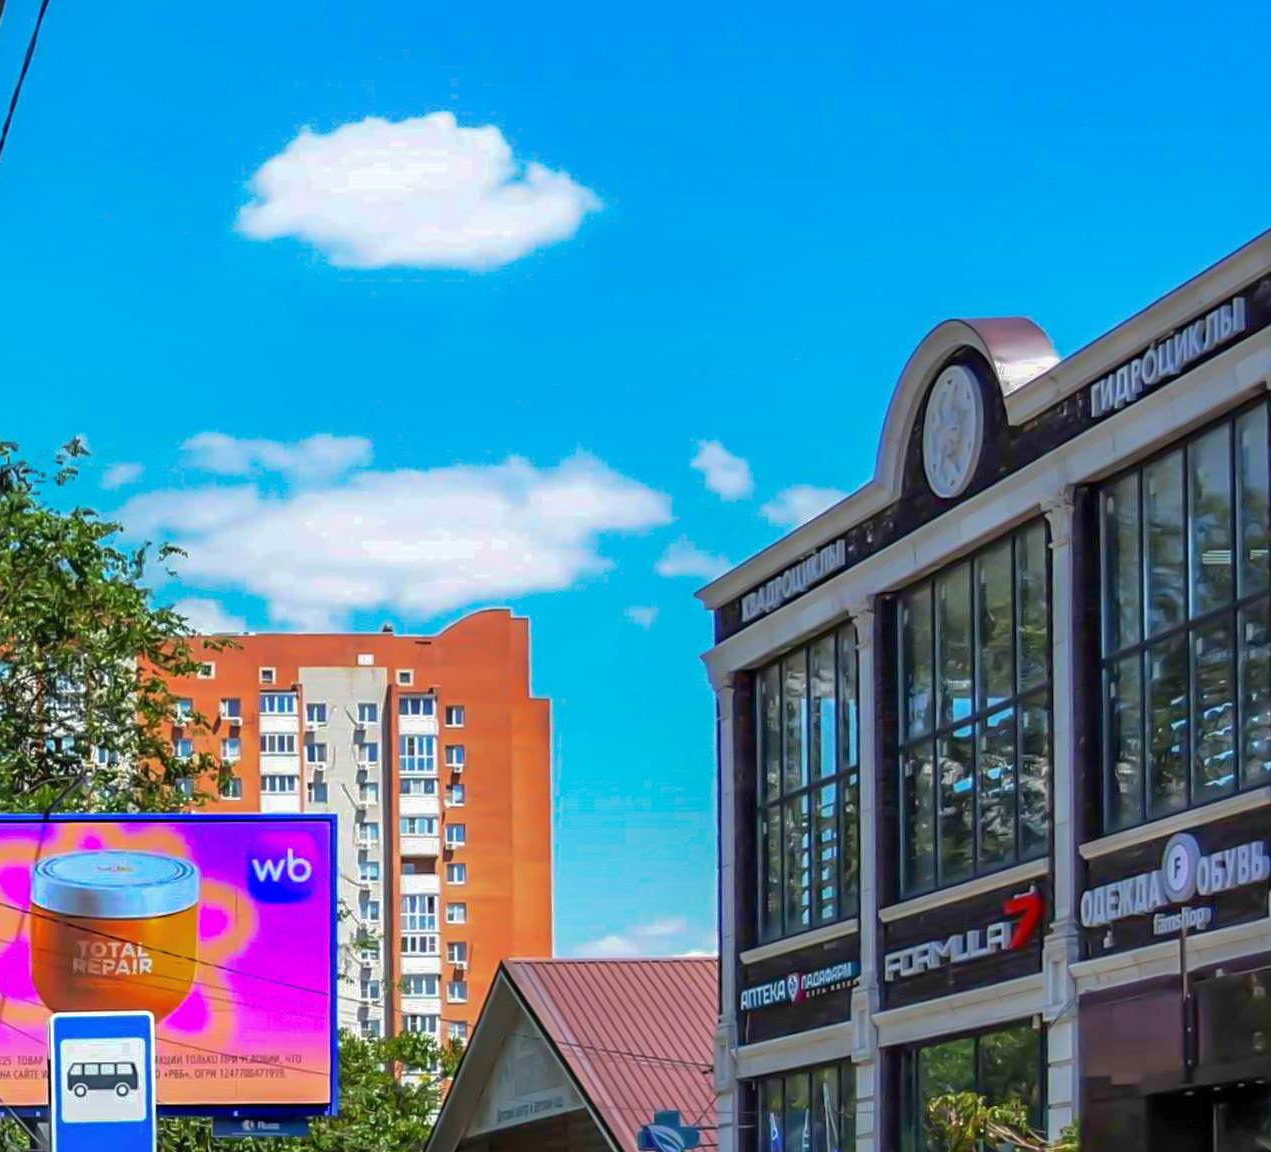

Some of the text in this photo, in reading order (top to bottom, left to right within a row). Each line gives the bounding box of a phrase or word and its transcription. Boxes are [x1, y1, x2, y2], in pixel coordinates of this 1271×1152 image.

[1090, 296, 1247, 418] ГИДРОЦИКЛЫ
[252, 848, 312, 883] wb
[1080, 841, 1270, 928] ОДЕЖДА ОБУВЬ
[77, 940, 150, 960] TOTAL
[71, 958, 153, 976] REPAIR
[740, 979, 786, 1011] АПТЕКА
[186, 1054, 218, 1064] ТОЛЬКО
[0, 1069, 10, 1080] НА
[13, 1068, 37, 1080] САЙТЕ
